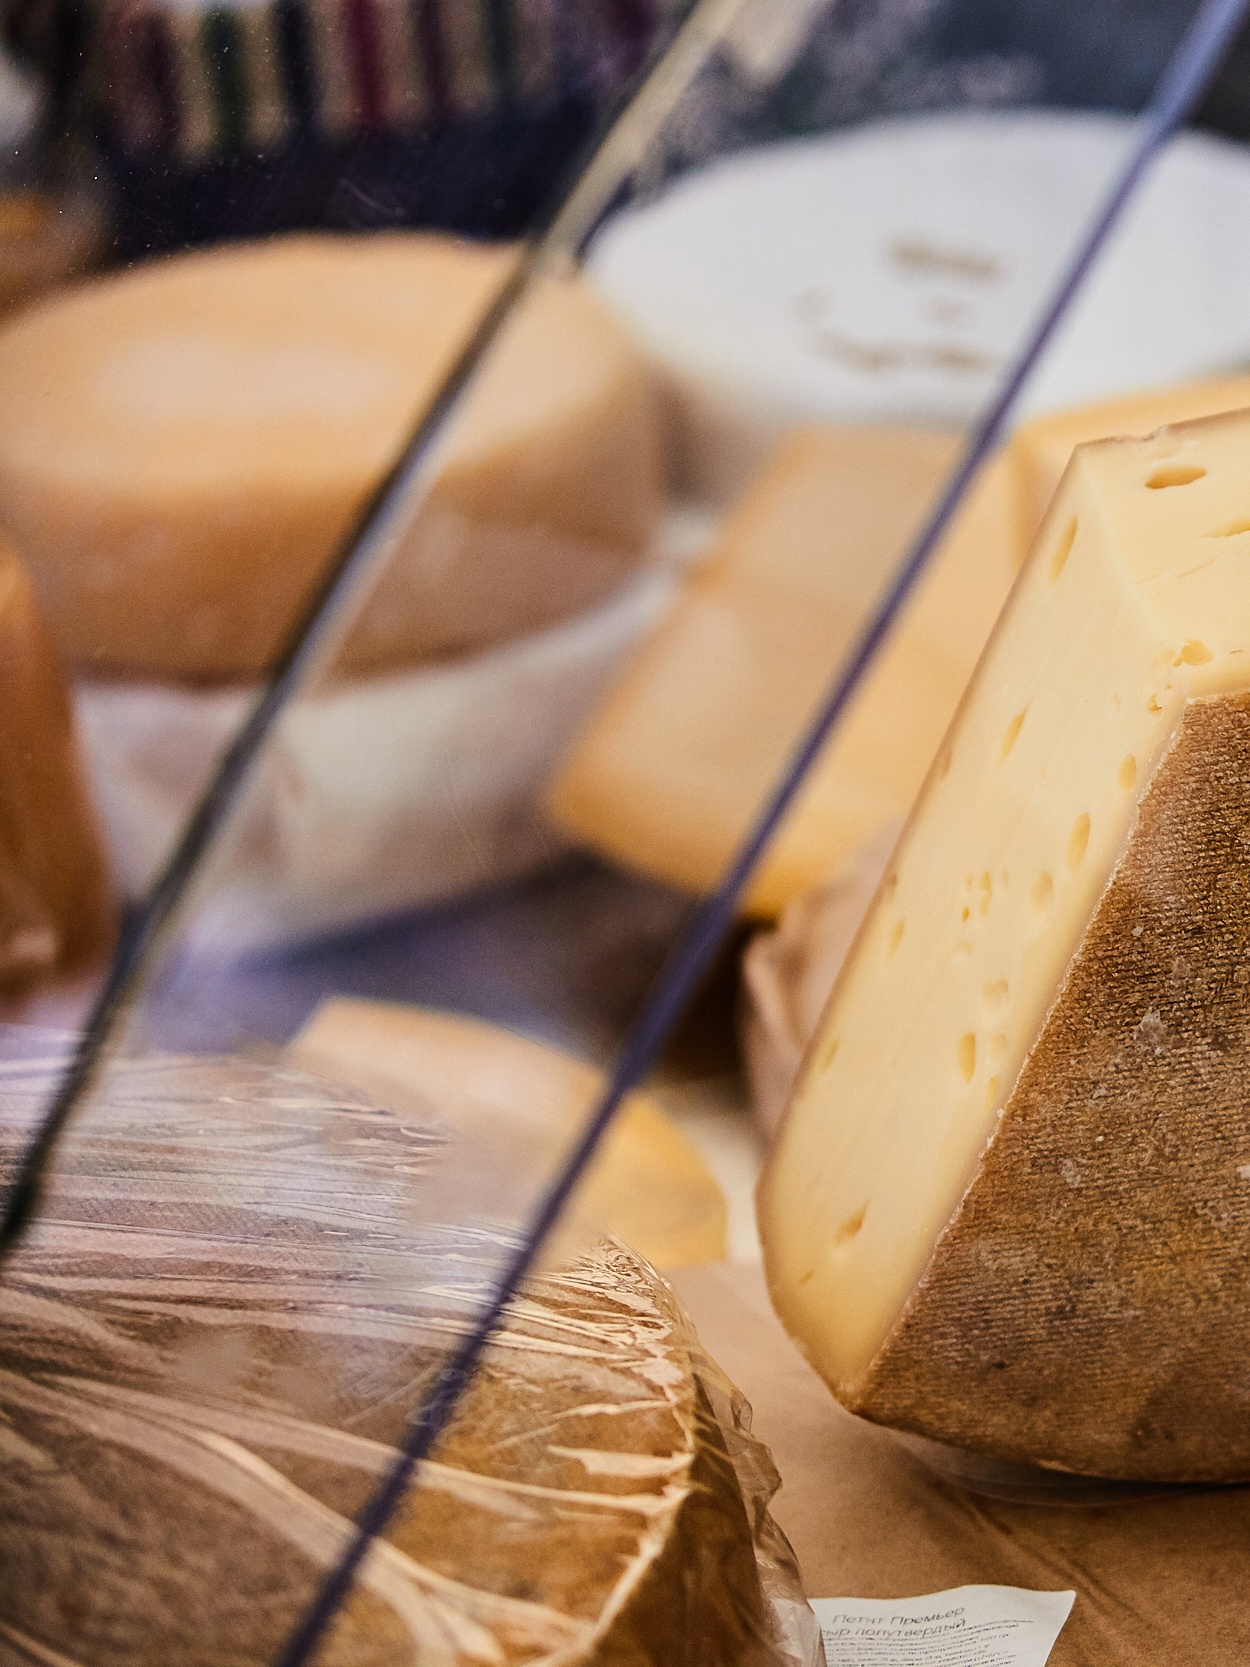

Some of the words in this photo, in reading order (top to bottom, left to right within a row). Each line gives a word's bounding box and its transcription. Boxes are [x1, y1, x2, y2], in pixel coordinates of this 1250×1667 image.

[832, 1614, 885, 1624] Петит
[889, 1607, 965, 1626] Премьер
[822, 1628, 850, 1638] ыр
[855, 1618, 966, 1638] полутвердый
